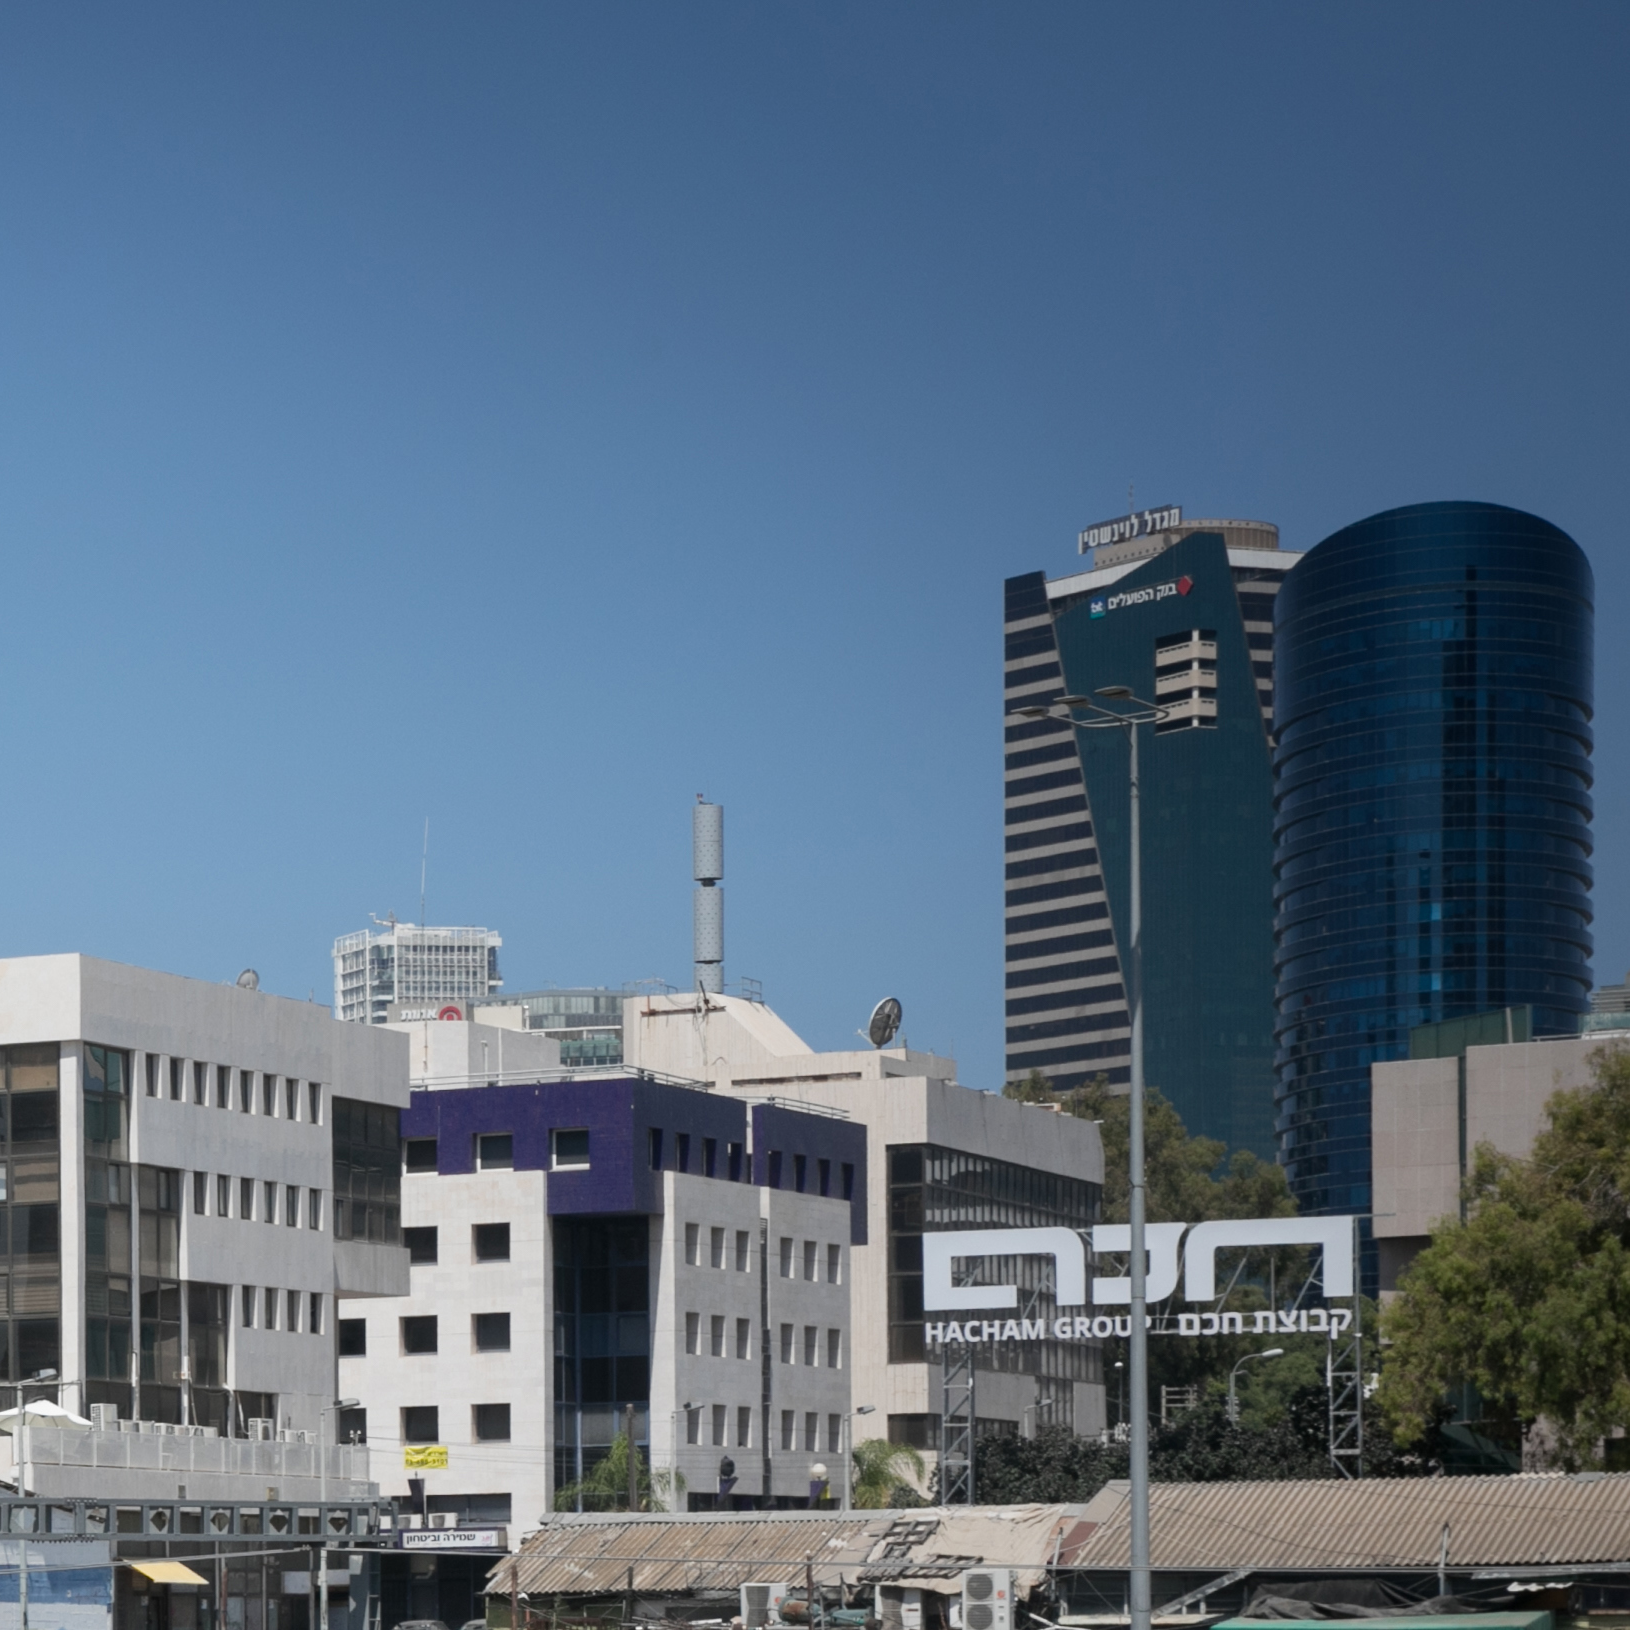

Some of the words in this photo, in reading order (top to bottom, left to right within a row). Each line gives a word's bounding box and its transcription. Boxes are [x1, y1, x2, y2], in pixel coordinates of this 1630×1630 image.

[1144, 507, 1180, 533] מגדל
[1108, 588, 1154, 610] הפועלים
[1157, 583, 1177, 600] בנק
[923, 1215, 1354, 1311] חכם
[925, 1319, 1045, 1343] HACHAM
[1178, 1312, 1242, 1336] חכם
[1253, 1308, 1352, 1340] קבוצת
[406, 1534, 440, 1545] וביטחון
[443, 1533, 476, 1543] שמירה
